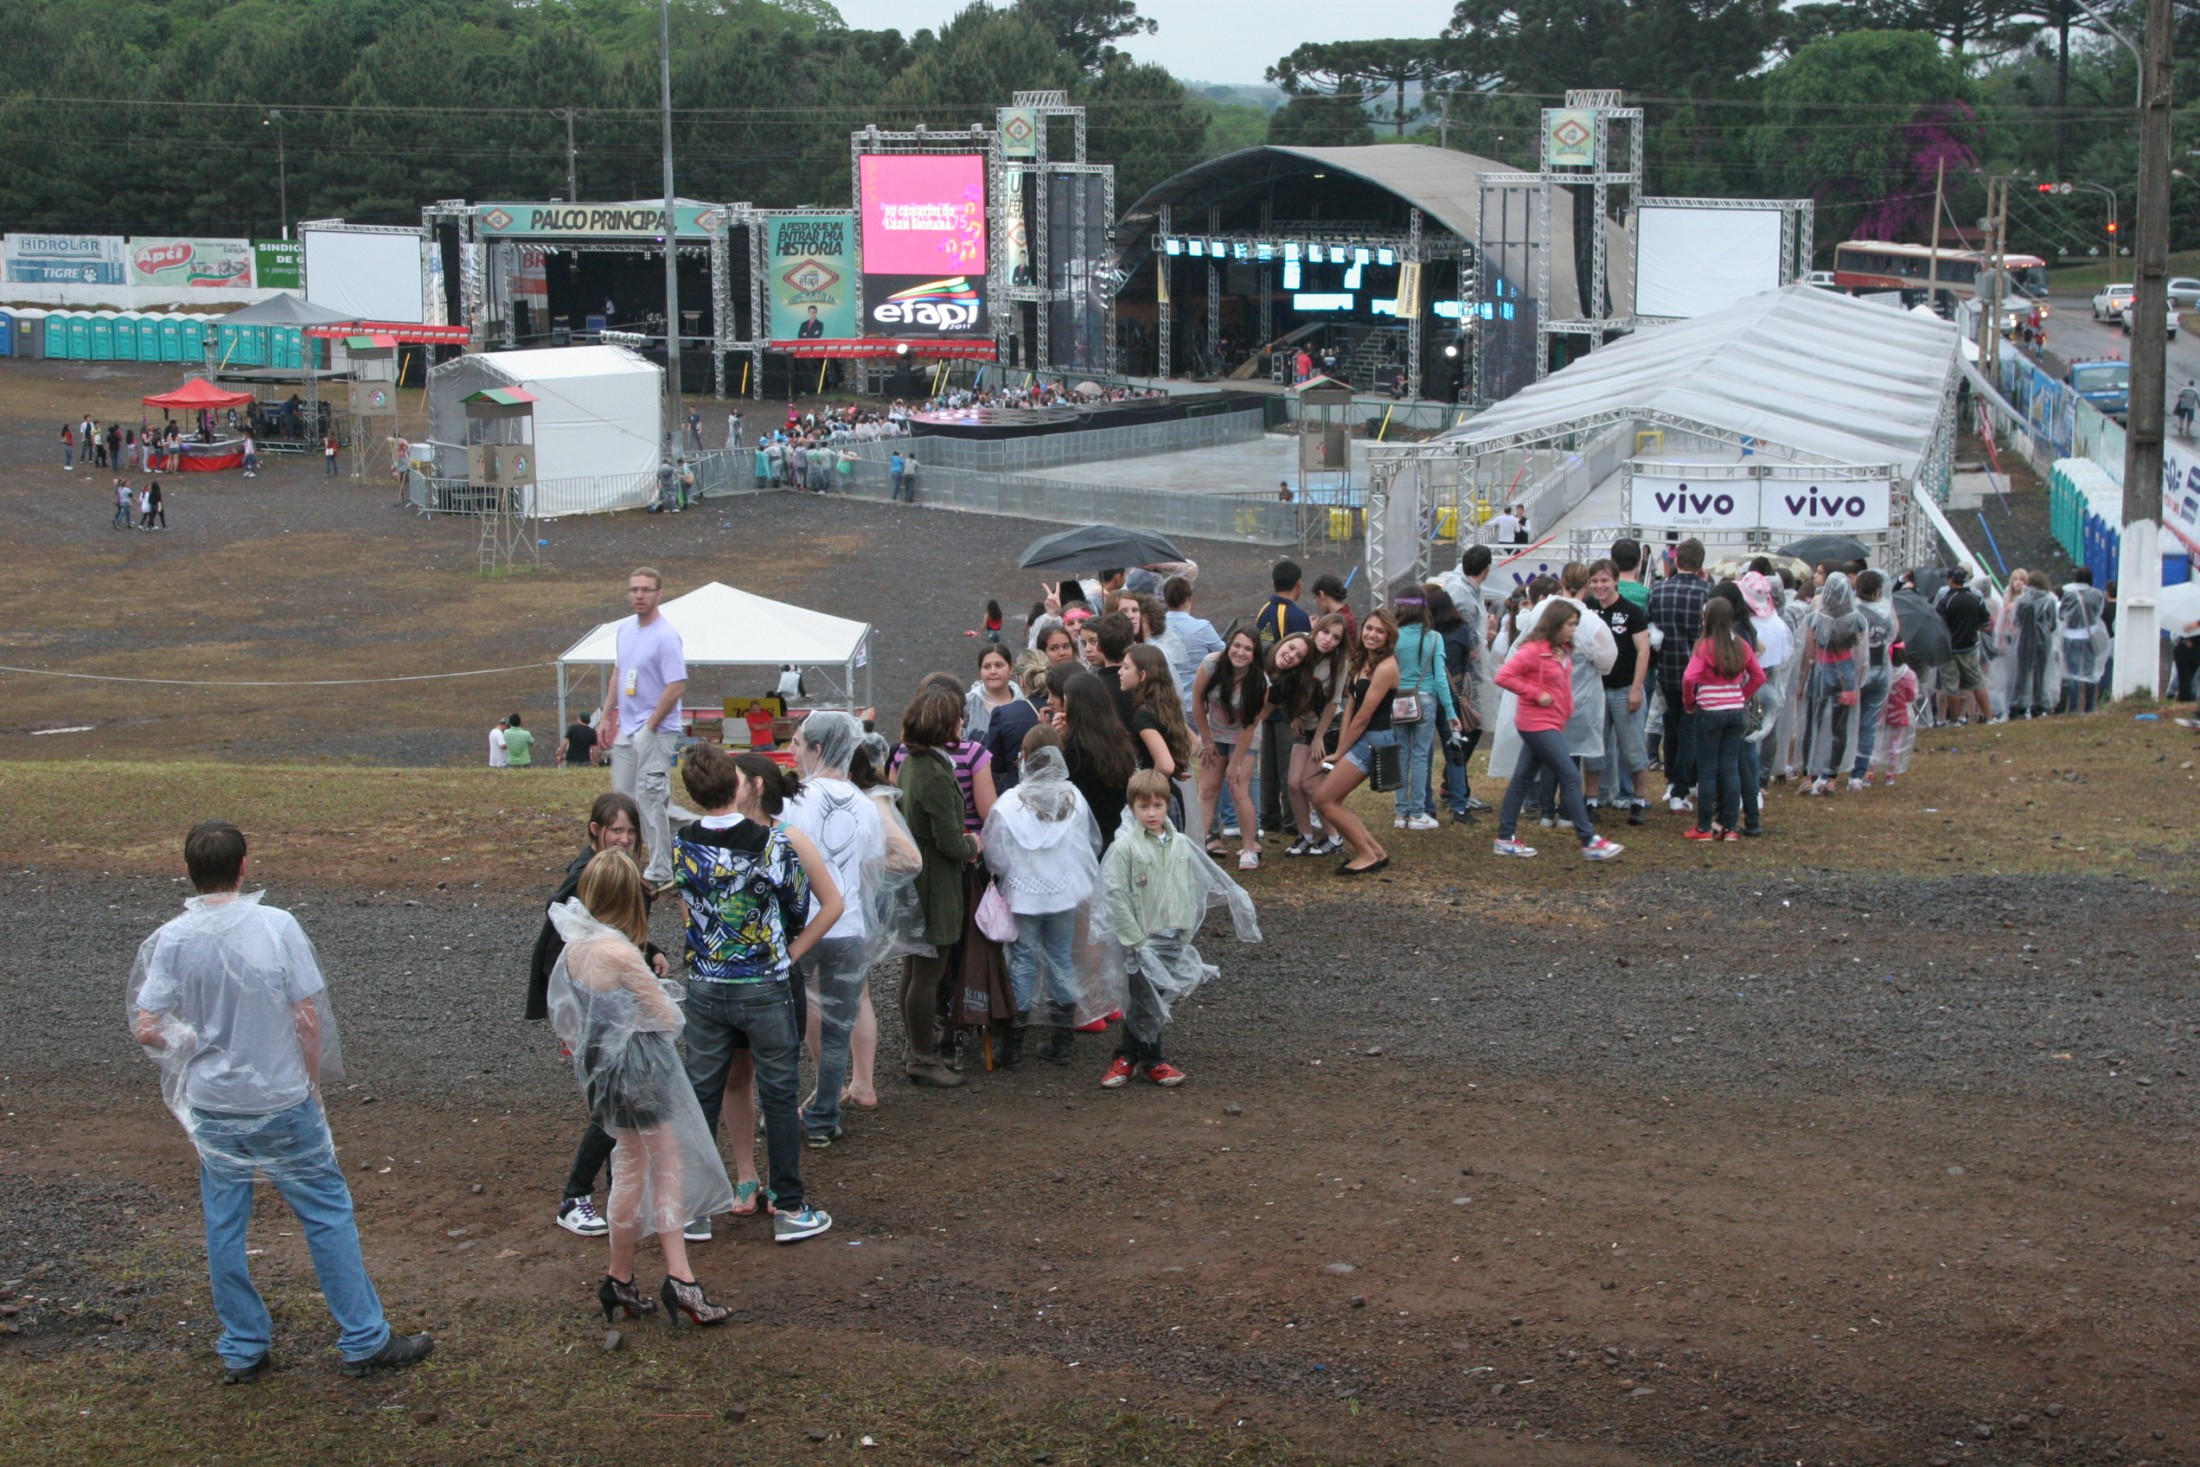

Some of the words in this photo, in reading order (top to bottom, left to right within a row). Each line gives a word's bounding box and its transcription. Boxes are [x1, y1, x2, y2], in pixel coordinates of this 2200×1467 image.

[531, 210, 587, 231] PALCO
[589, 210, 677, 232] PRINCIPA
[779, 222, 787, 231] A
[787, 222, 811, 231] FESTA
[812, 222, 829, 231] QUE
[777, 231, 819, 242] ENTRAR
[822, 231, 844, 242] PRA
[20, 238, 101, 251] HIDROLAR
[276, 255, 293, 264] DE
[42, 267, 80, 279] TIGRE
[873, 298, 978, 330] efapi
[1655, 483, 1734, 515] vivo
[1784, 486, 1866, 517] vivo
